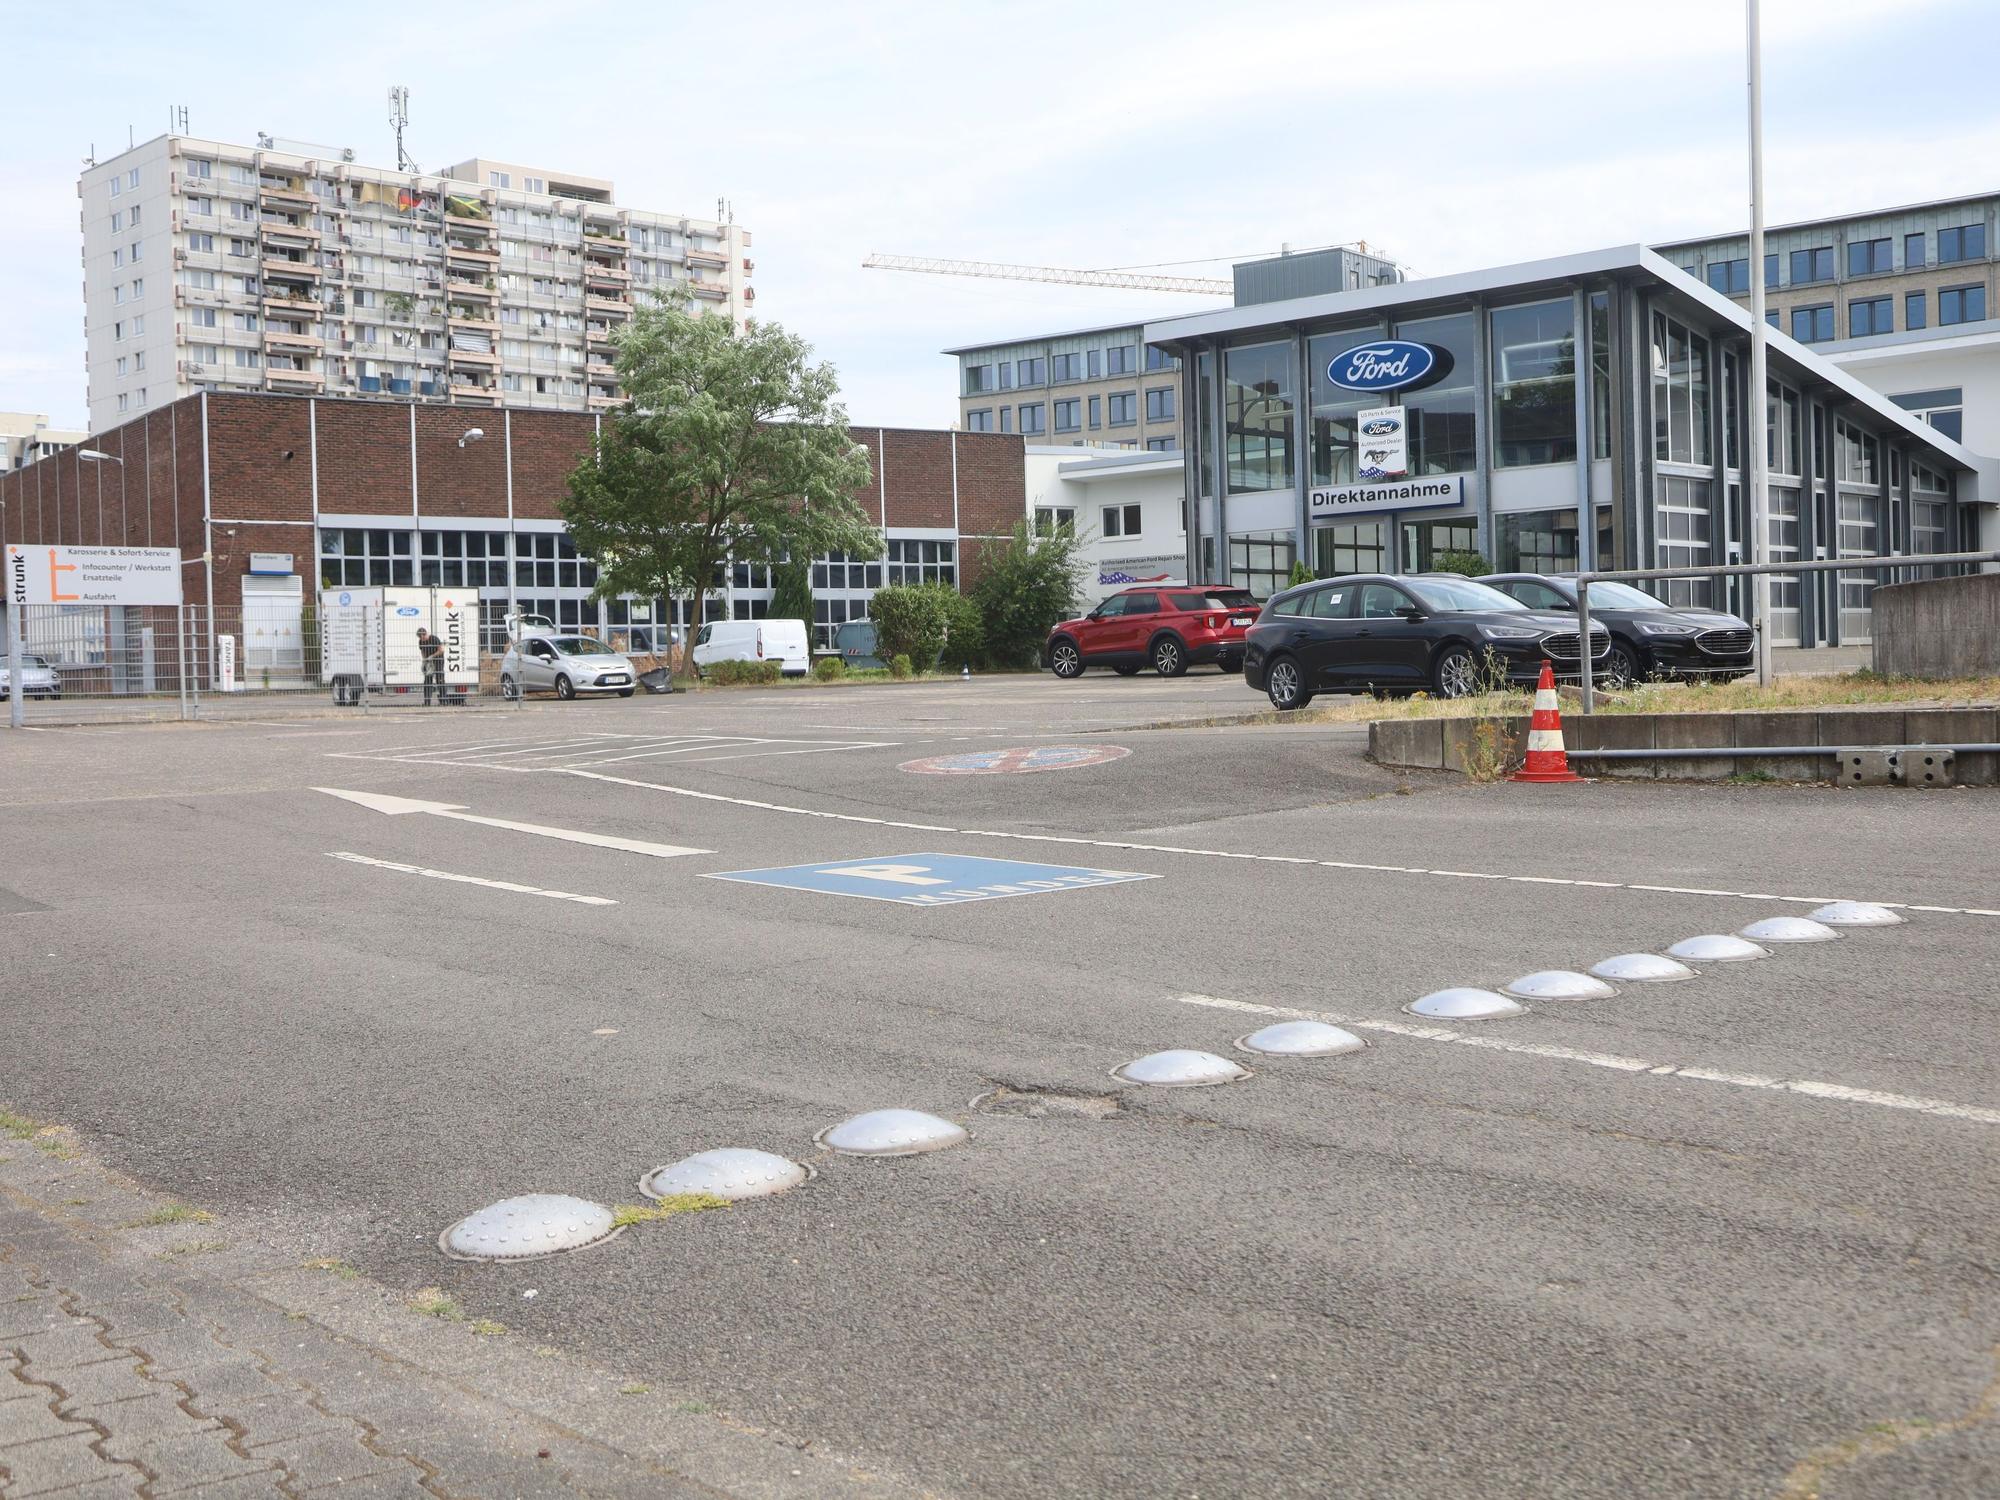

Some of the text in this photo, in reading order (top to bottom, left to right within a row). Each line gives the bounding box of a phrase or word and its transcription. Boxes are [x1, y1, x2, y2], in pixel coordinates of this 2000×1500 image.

[1346, 348, 1411, 382] Ford
[1368, 420, 1393, 435] Ford
[1387, 437, 1402, 445] Dealer
[1312, 483, 1451, 506] Direktannahme
[67, 548, 107, 556] Karosserie
[118, 549, 170, 557] Sofort-Service
[12, 554, 26, 602] strunk
[82, 563, 127, 571] Infocounter
[445, 612, 459, 672] strunk
[901, 873, 1142, 903] KUNDEN
